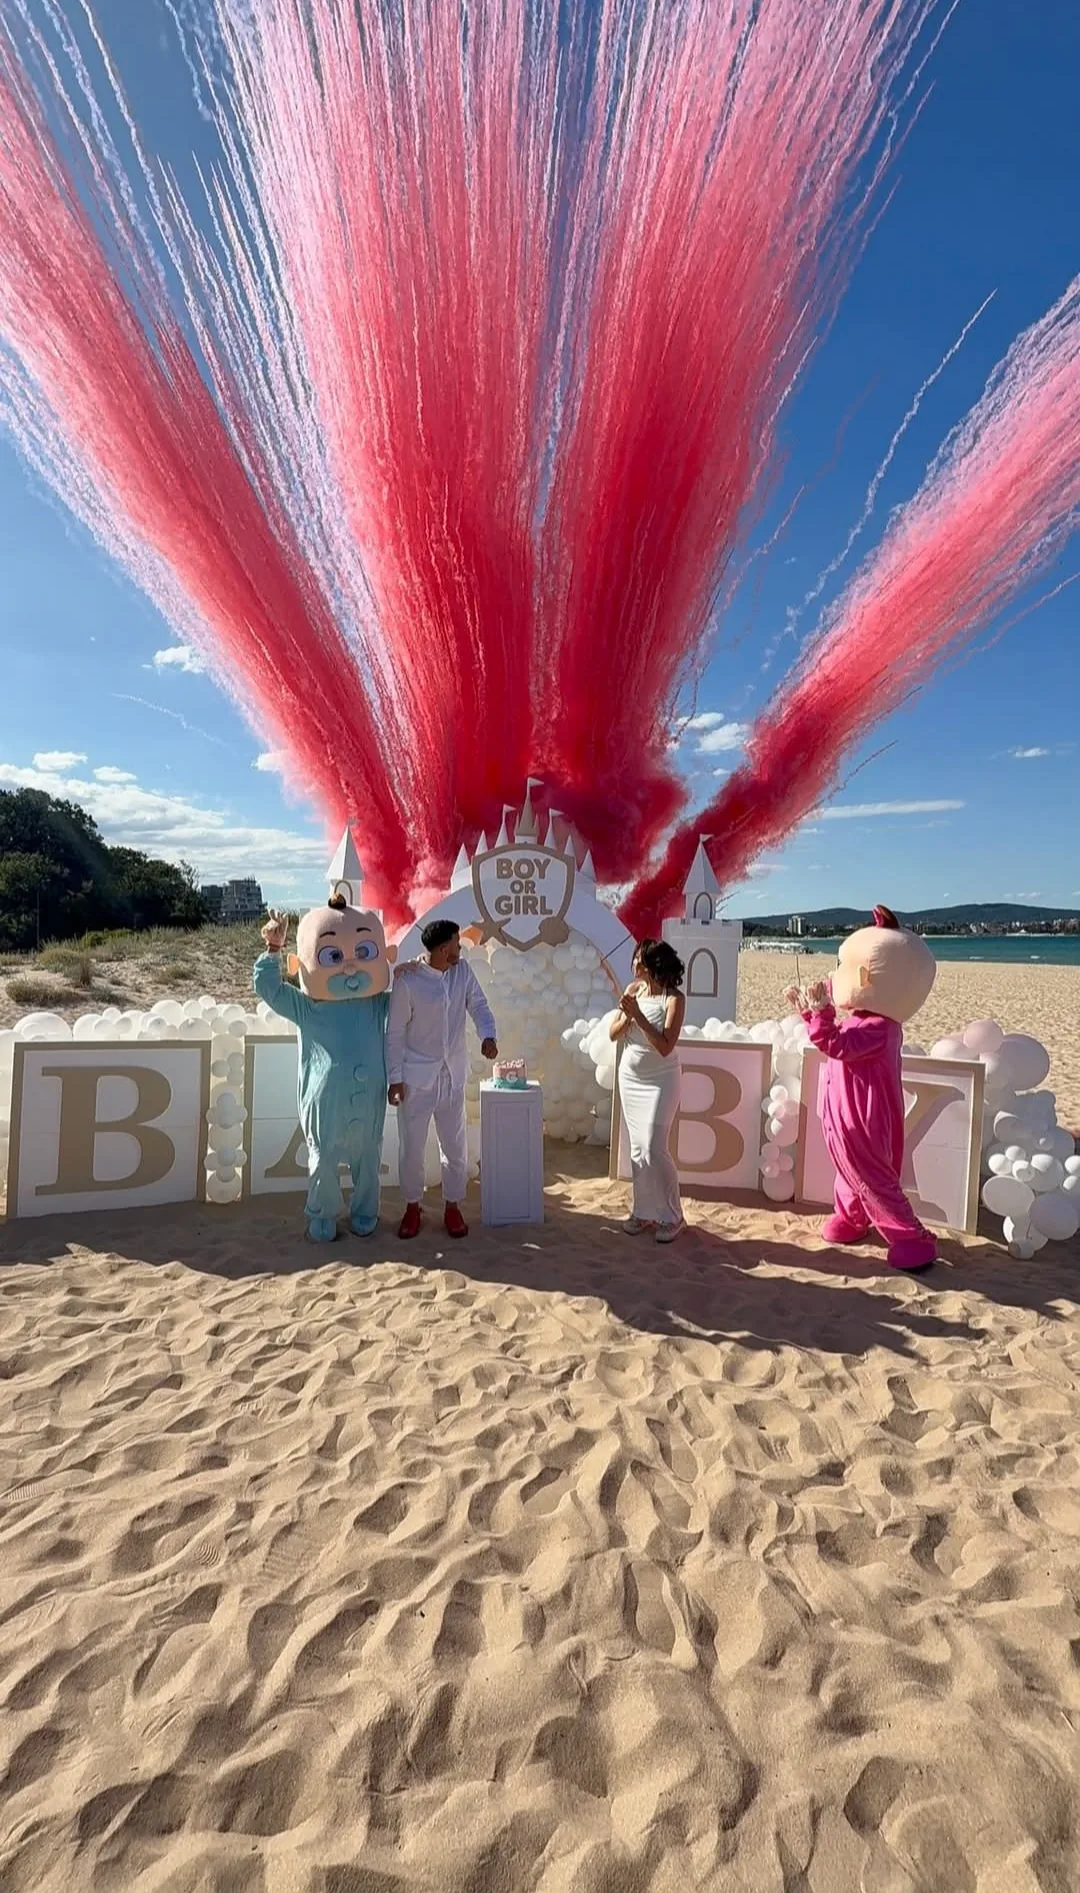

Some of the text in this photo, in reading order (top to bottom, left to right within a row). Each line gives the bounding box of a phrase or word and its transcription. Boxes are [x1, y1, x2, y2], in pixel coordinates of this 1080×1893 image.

[496, 858, 551, 879] BOY
[510, 880, 536, 894] OR
[495, 895, 553, 915] GIRL
